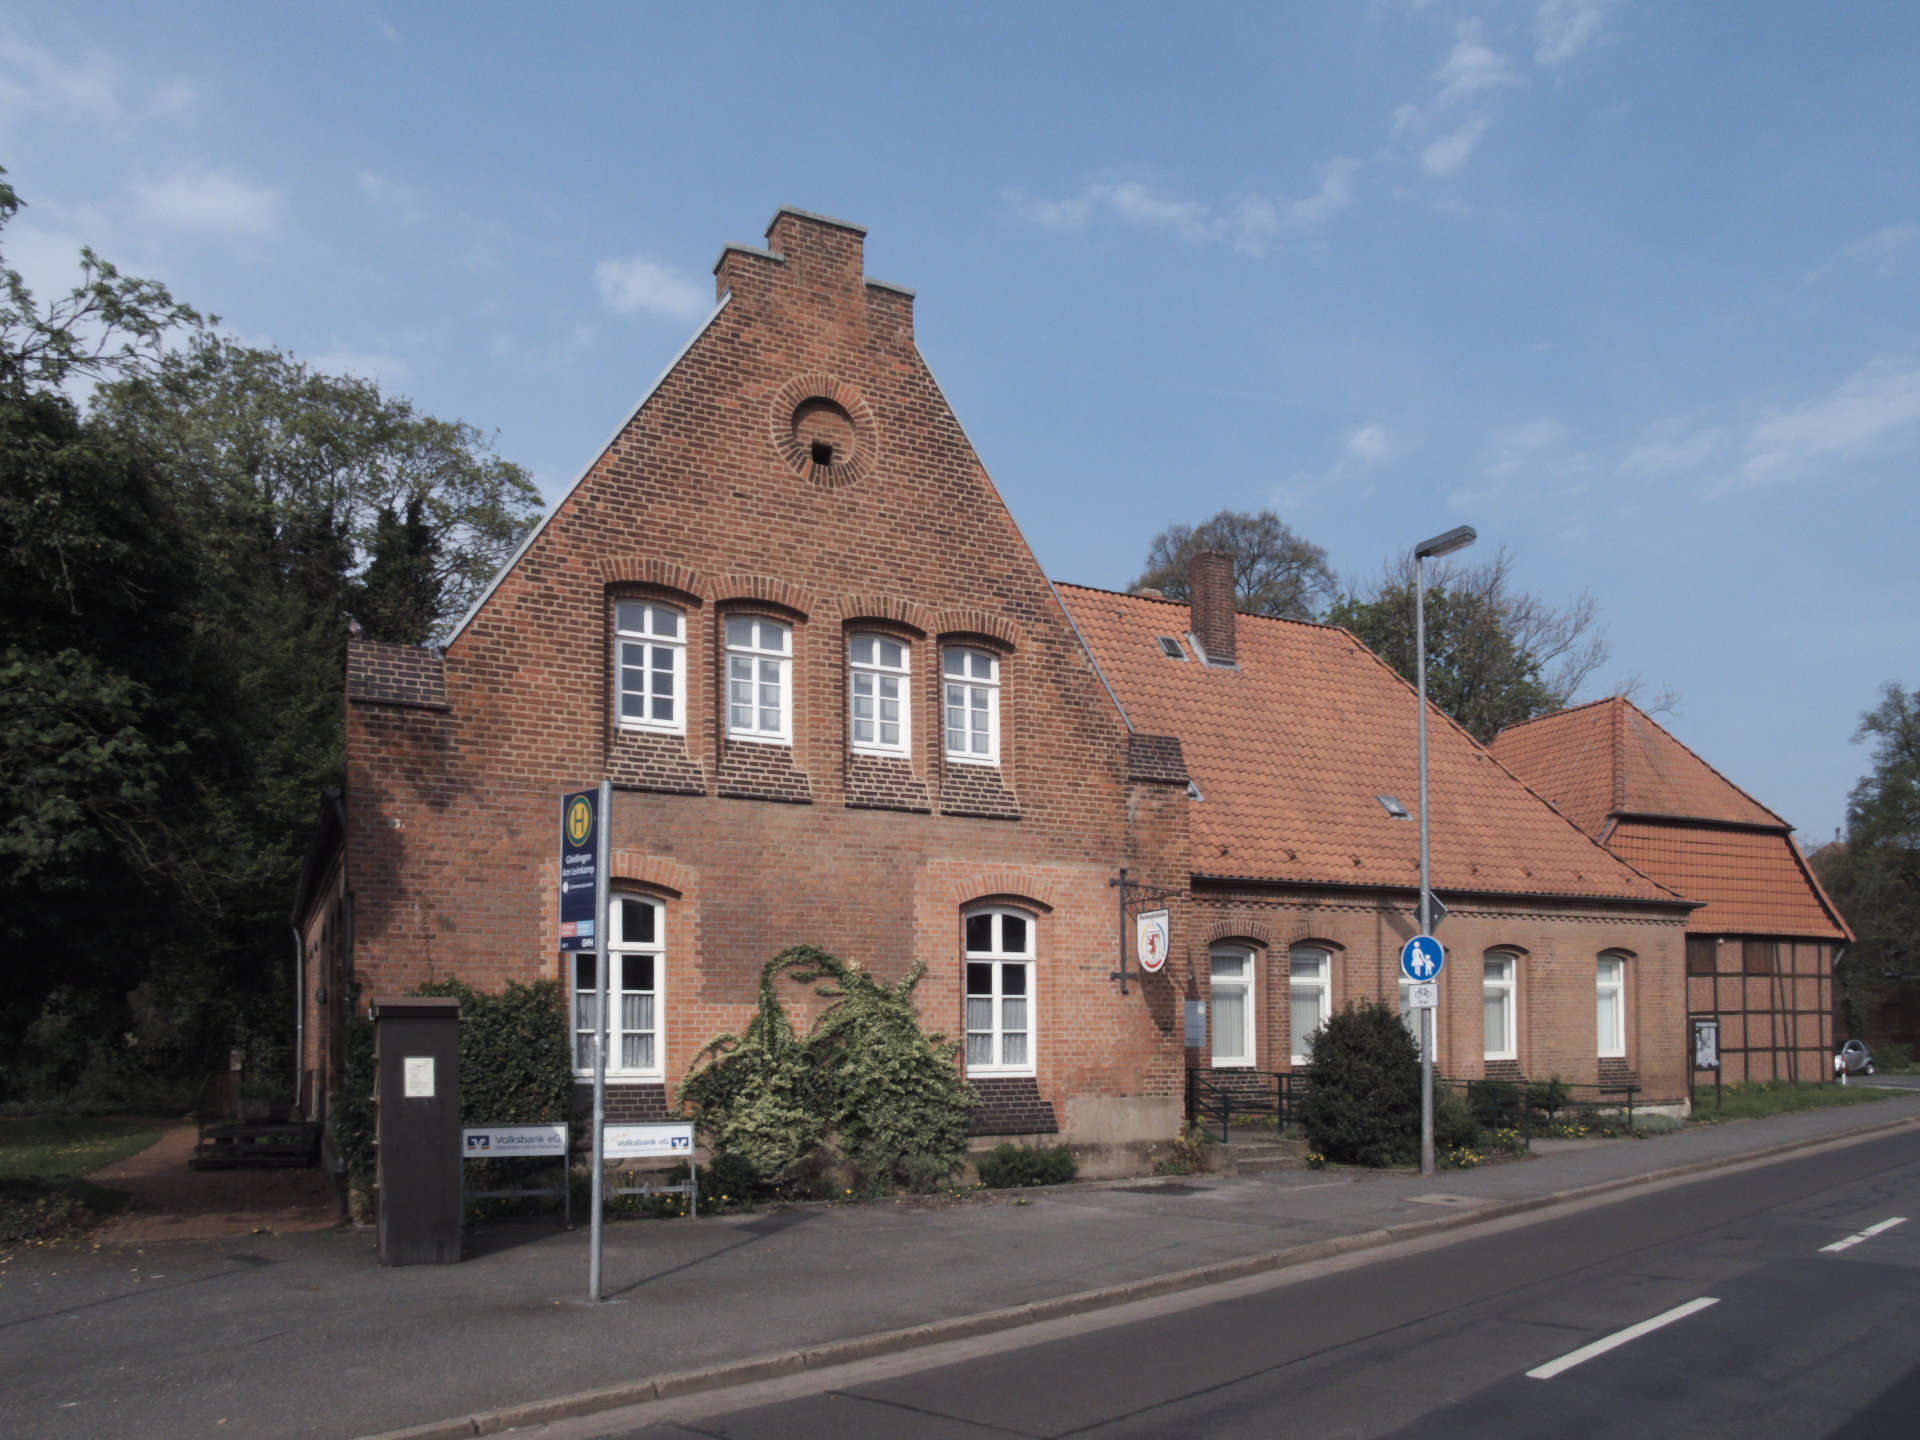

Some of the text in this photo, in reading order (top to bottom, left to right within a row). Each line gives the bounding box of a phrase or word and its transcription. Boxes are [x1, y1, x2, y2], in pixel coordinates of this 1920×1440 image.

[566, 854, 592, 864] Gleidingen
[562, 866, 595, 876] Am Leinkamp
[582, 939, 594, 947] GVH
[495, 1134, 561, 1144] Volksbank eG
[617, 1137, 669, 1147] Volksbank eG
